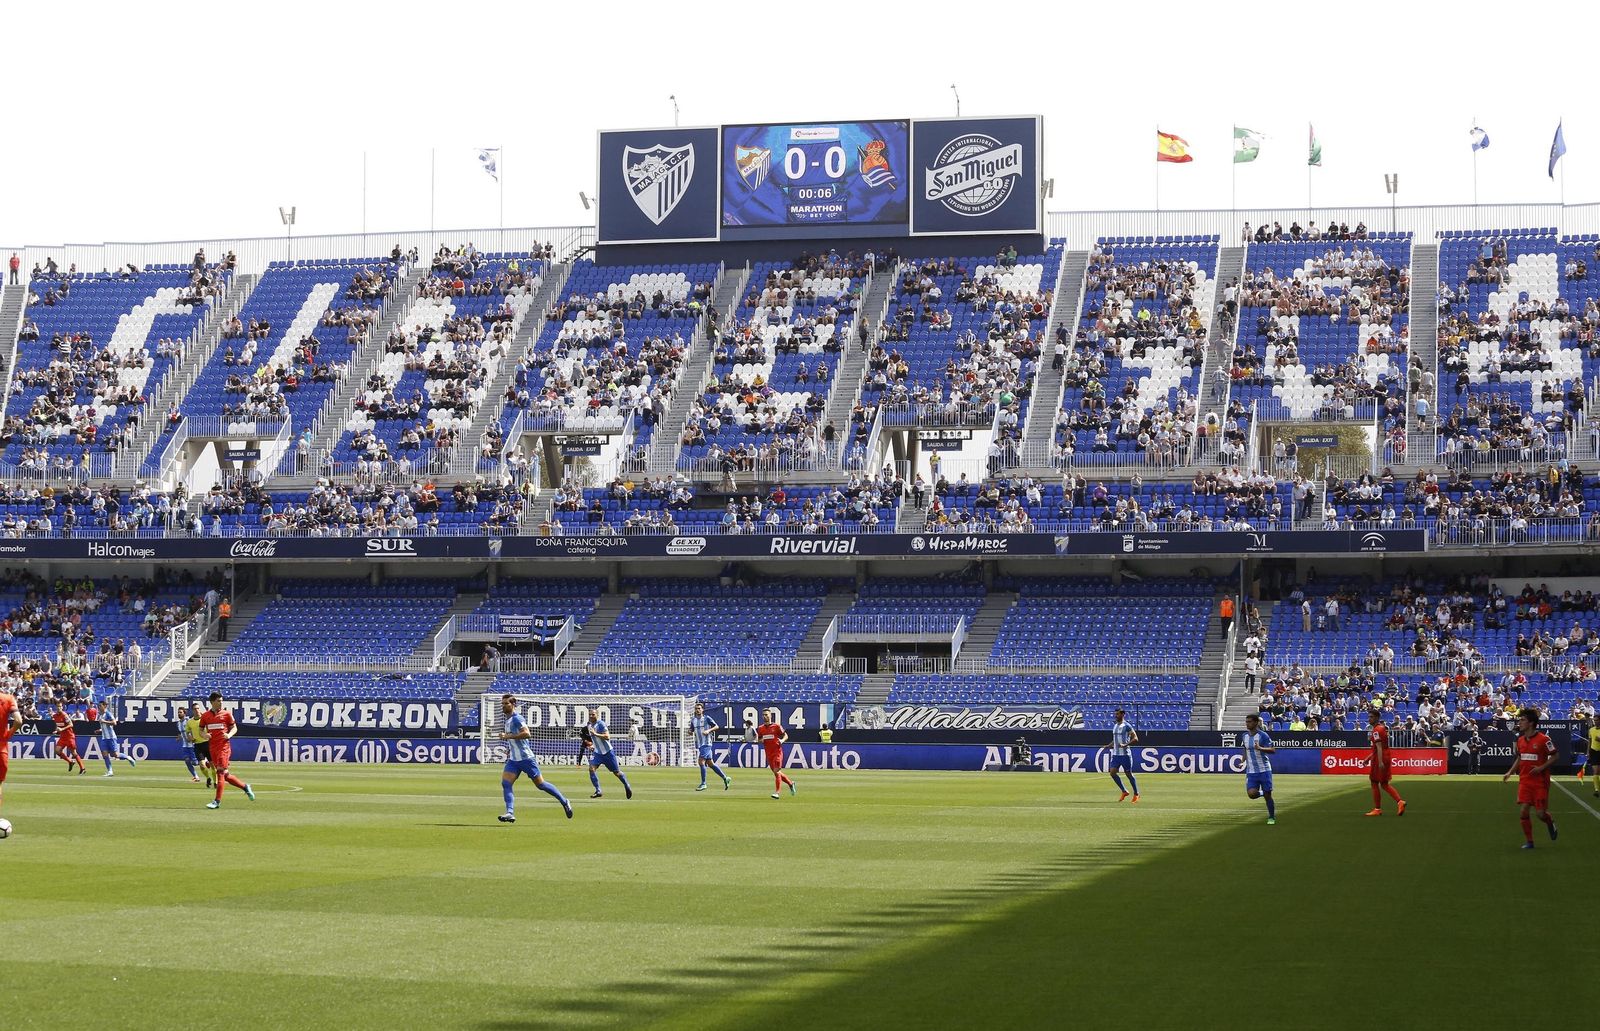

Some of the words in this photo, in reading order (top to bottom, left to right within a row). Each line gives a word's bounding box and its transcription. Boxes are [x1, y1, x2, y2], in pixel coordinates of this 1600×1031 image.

[955, 138, 994, 148] INTERNACIONAL
[799, 188, 833, 199] 00:06
[790, 204, 843, 213] MARATHON
[947, 197, 971, 212] EXPLORING
[980, 199, 997, 210] WORLD
[230, 539, 279, 557] Coca-Cola
[366, 538, 415, 552] SUR
[535, 536, 563, 547] DOÑA
[564, 537, 628, 548] FRANCISQUITA
[770, 536, 856, 554] Rivervial
[567, 546, 597, 555] catering
[500, 618, 533, 626] SANCIONADOS
[502, 626, 530, 634] PRESENTES
[288, 702, 452, 729] BOKERON
[889, 705, 1046, 731] Malakas
[1047, 708, 1079, 730] 01
[1305, 738, 1314, 747] de
[1315, 738, 1347, 749] Málaga
[254, 738, 348, 763] Allianz
[785, 744, 861, 770] Auto
[1140, 747, 1247, 774] Seguro
[1391, 757, 1444, 767] Santander
